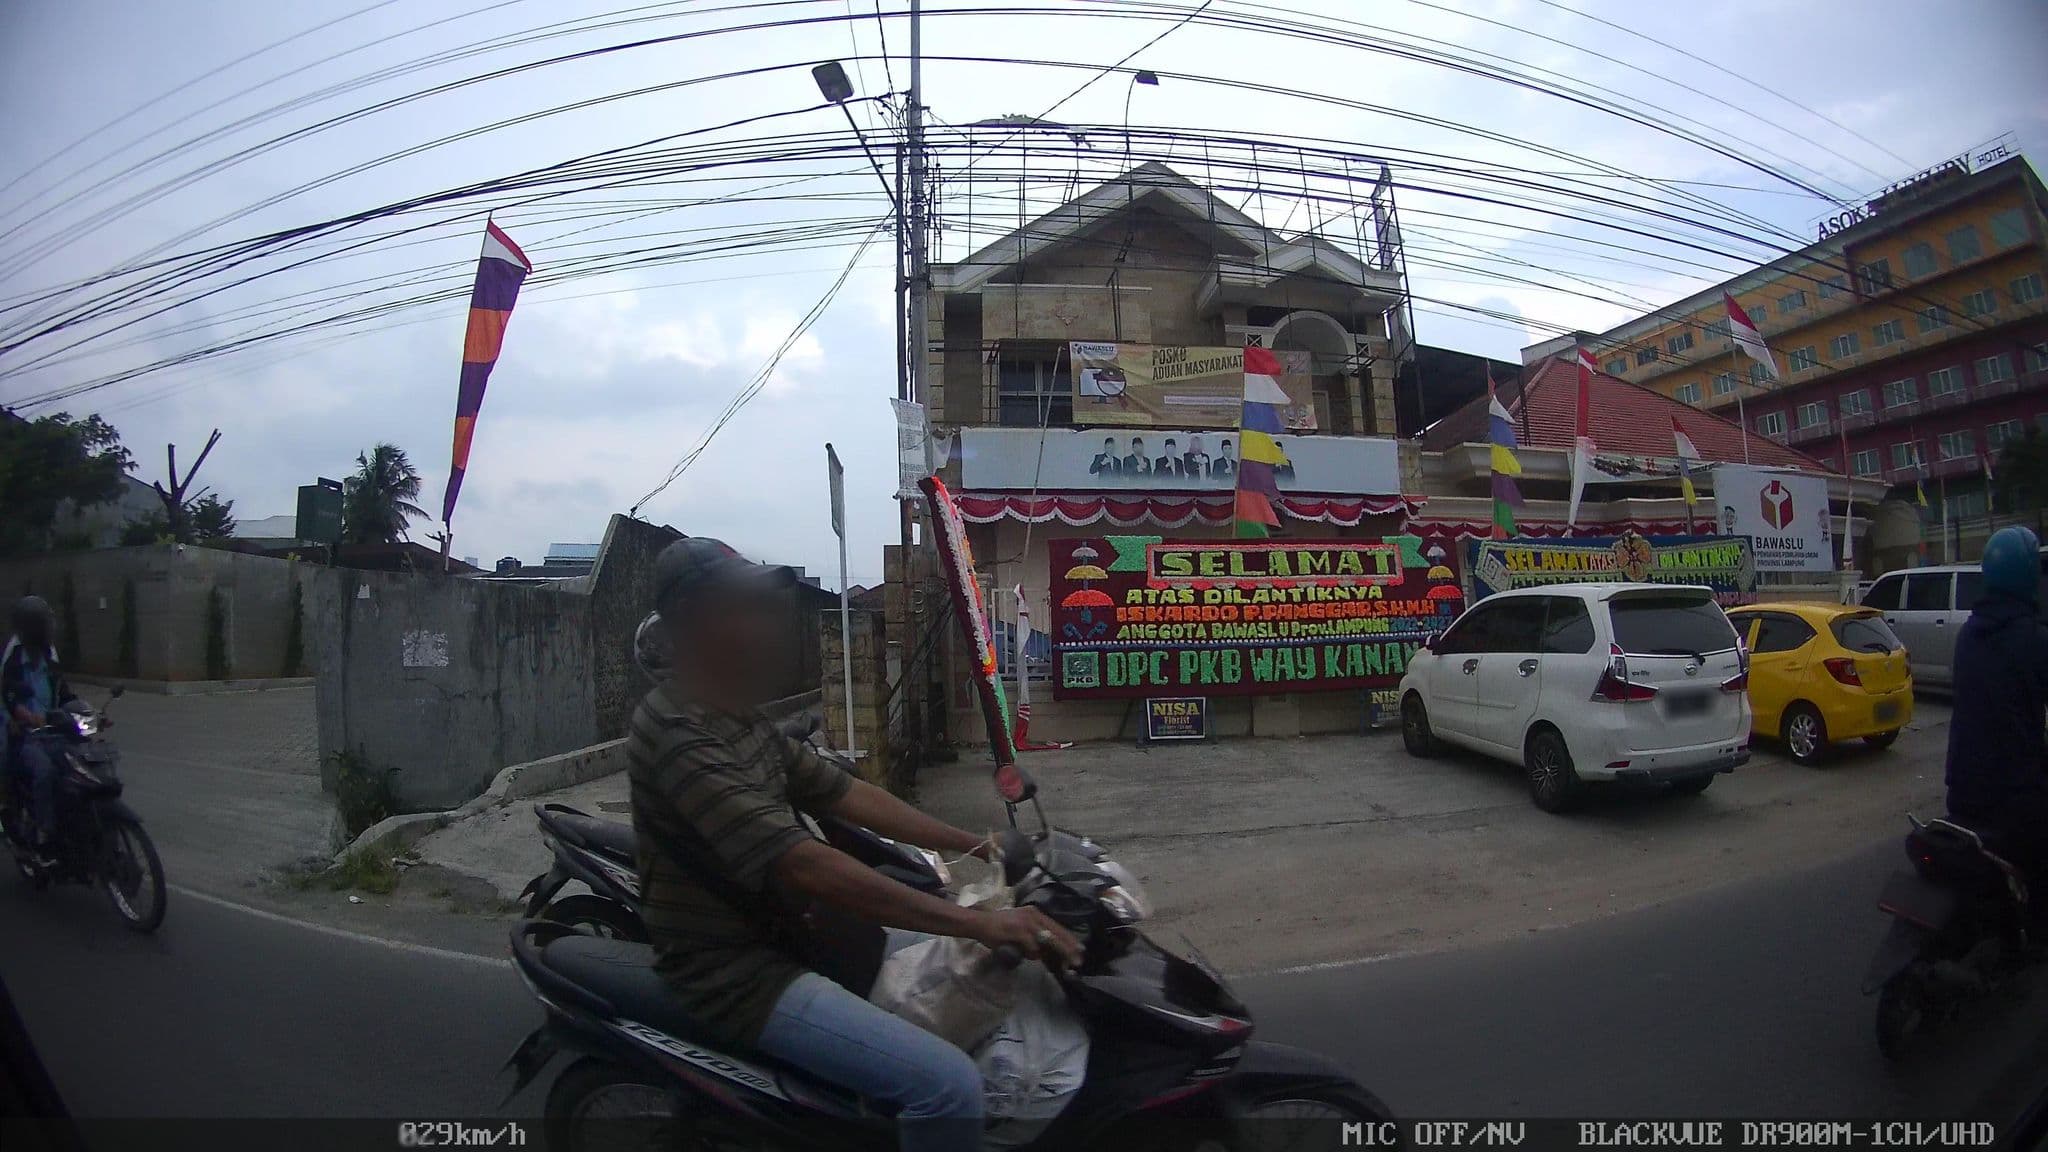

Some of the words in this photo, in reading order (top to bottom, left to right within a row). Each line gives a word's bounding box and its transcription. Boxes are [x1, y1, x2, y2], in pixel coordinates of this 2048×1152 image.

[1977, 145, 2011, 164] HOTEL
[1152, 364, 1183, 380] ADUAN
[1185, 354, 1243, 376] MASYARAKAT
[1755, 537, 1804, 550] BAWASLU
[1161, 549, 1394, 576] SELAMAT
[1504, 549, 1590, 571] SELAMAT
[1590, 552, 1614, 570] ATAS
[1126, 588, 1194, 604] ATAS
[1203, 585, 1383, 604] DILANTIKNYA
[1116, 605, 1239, 622] ISKARDO
[1116, 623, 1207, 639] ANGGOTA
[1212, 621, 1289, 638] BAWASLU
[1106, 651, 1169, 687] DPC
[1179, 649, 1241, 684] PKB
[1249, 646, 1317, 682] WAY
[1067, 676, 1094, 684] PKB
[1370, 690, 1400, 704] NIS
[1152, 702, 1200, 716] NISA
[626, 1023, 739, 1073] REVO
